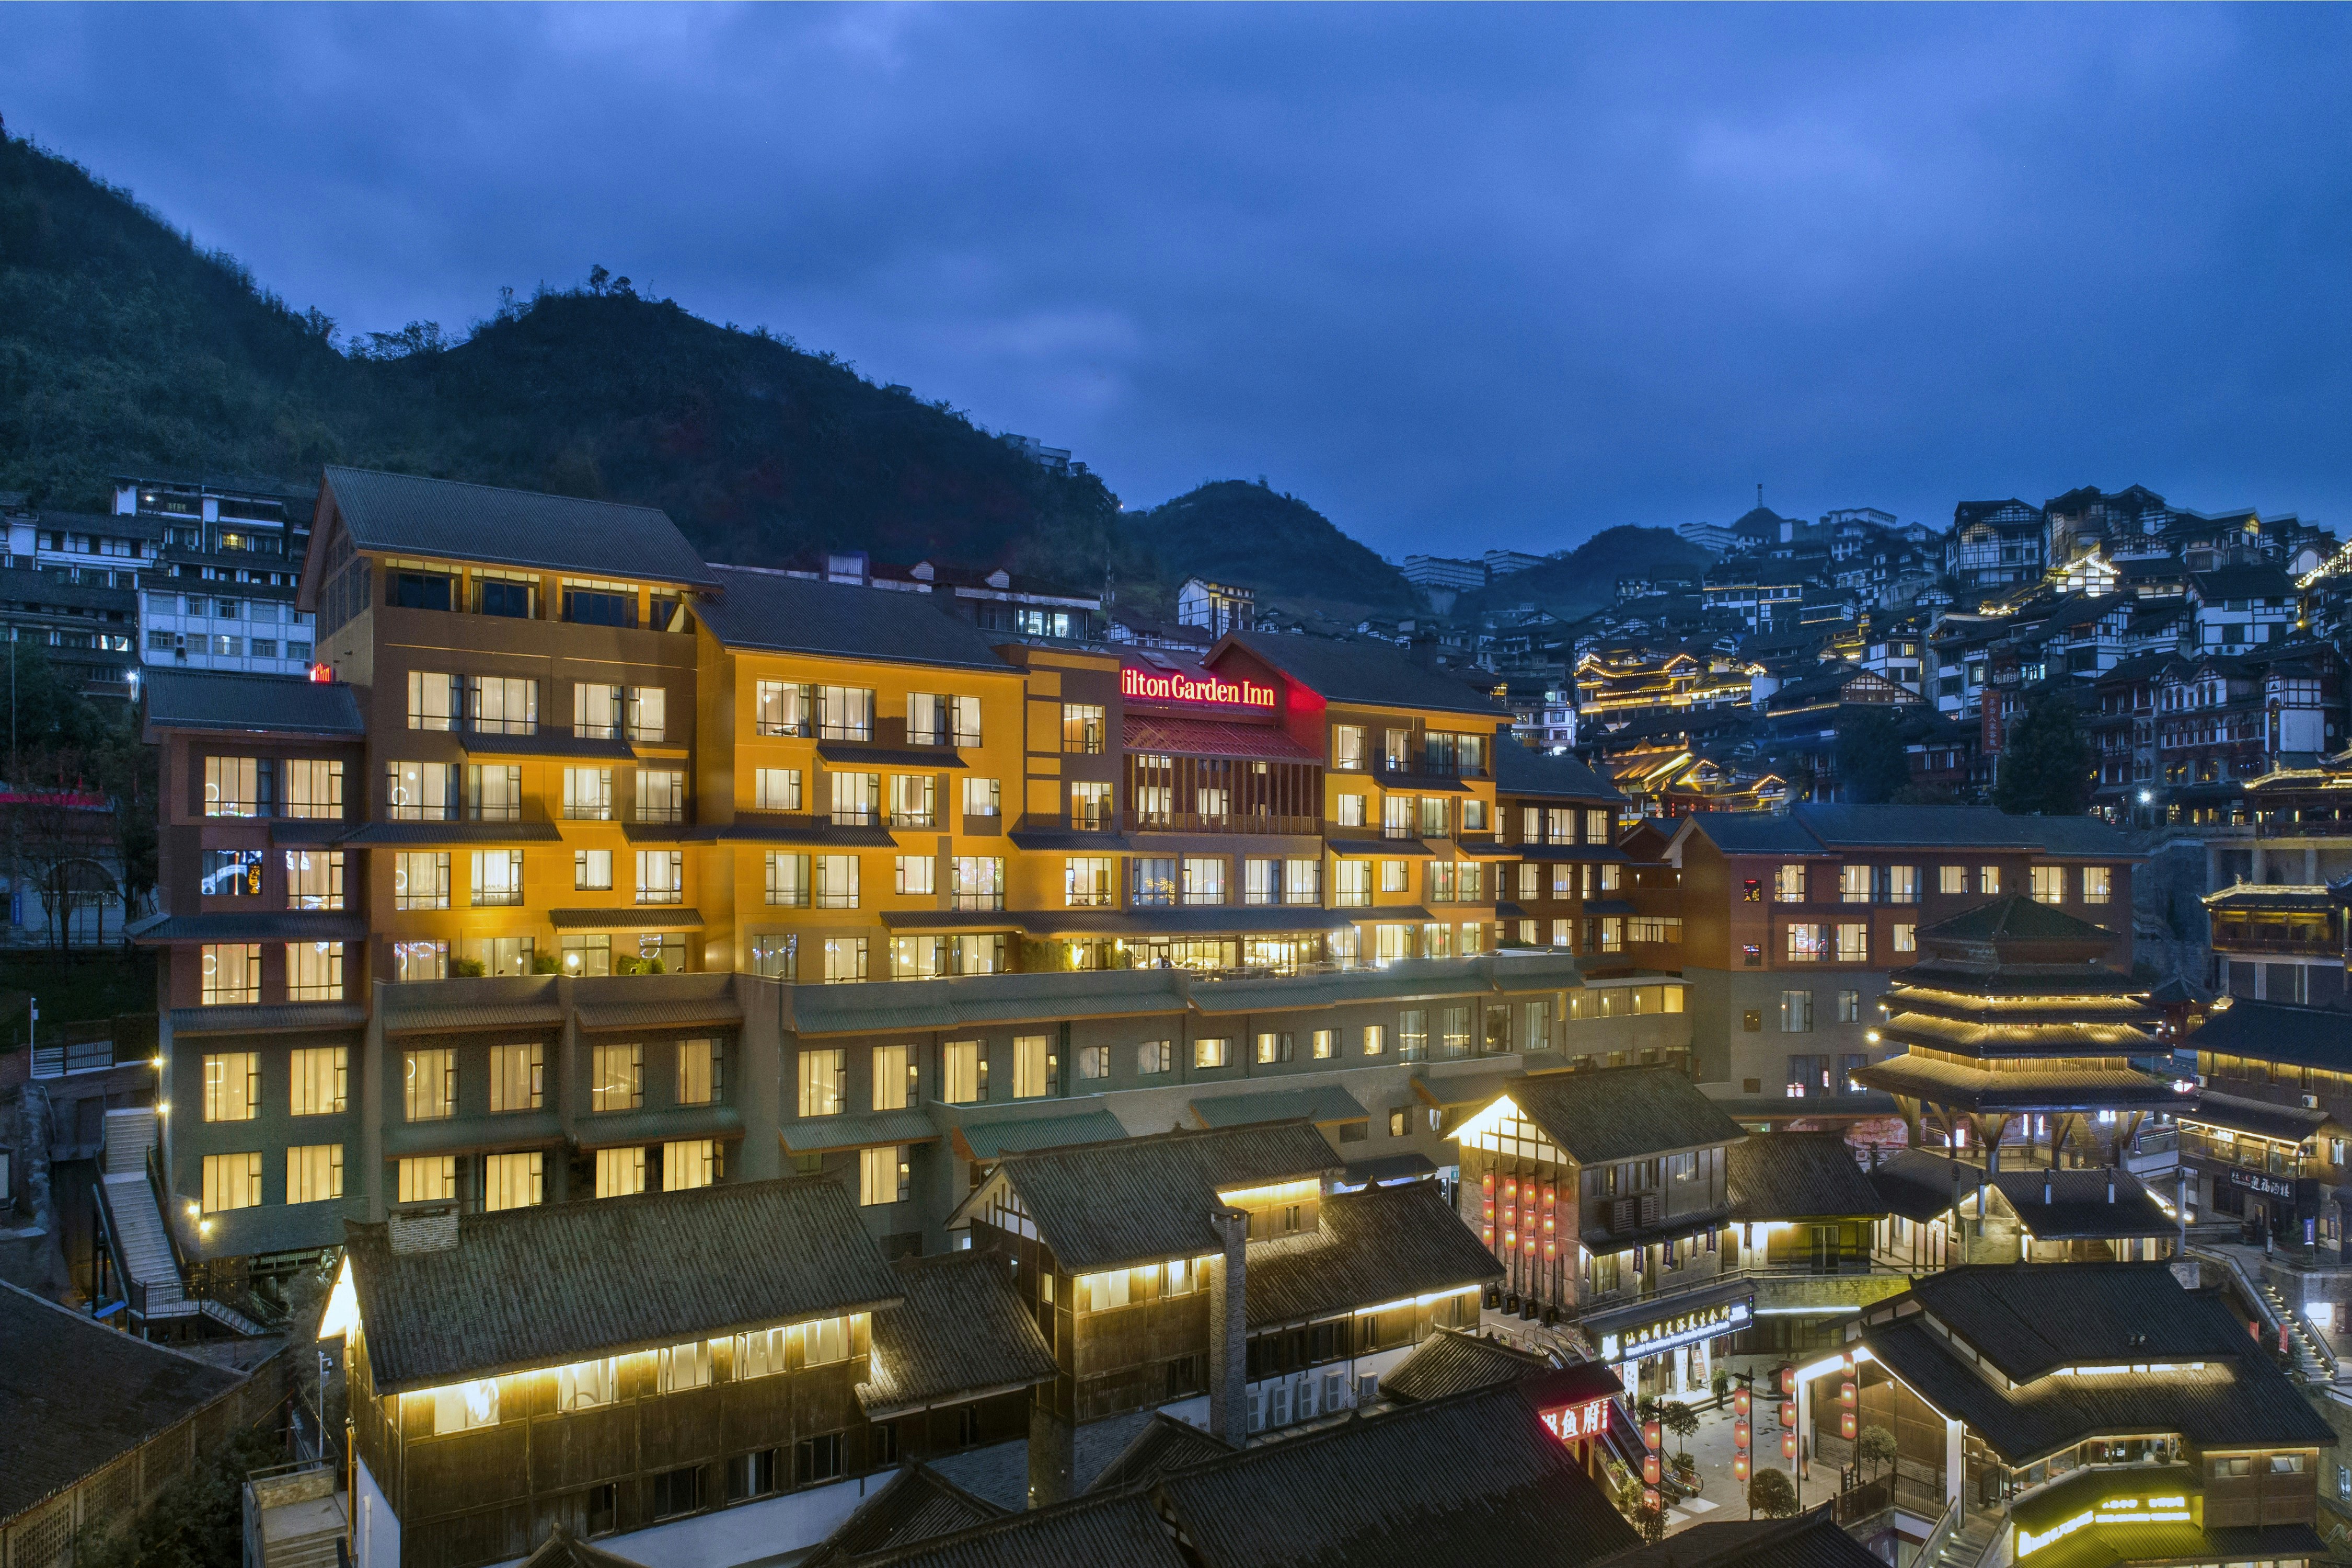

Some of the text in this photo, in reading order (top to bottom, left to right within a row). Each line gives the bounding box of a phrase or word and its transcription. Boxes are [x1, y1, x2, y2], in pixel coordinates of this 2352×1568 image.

[1122, 669, 1275, 706] ilton Garden Inn
